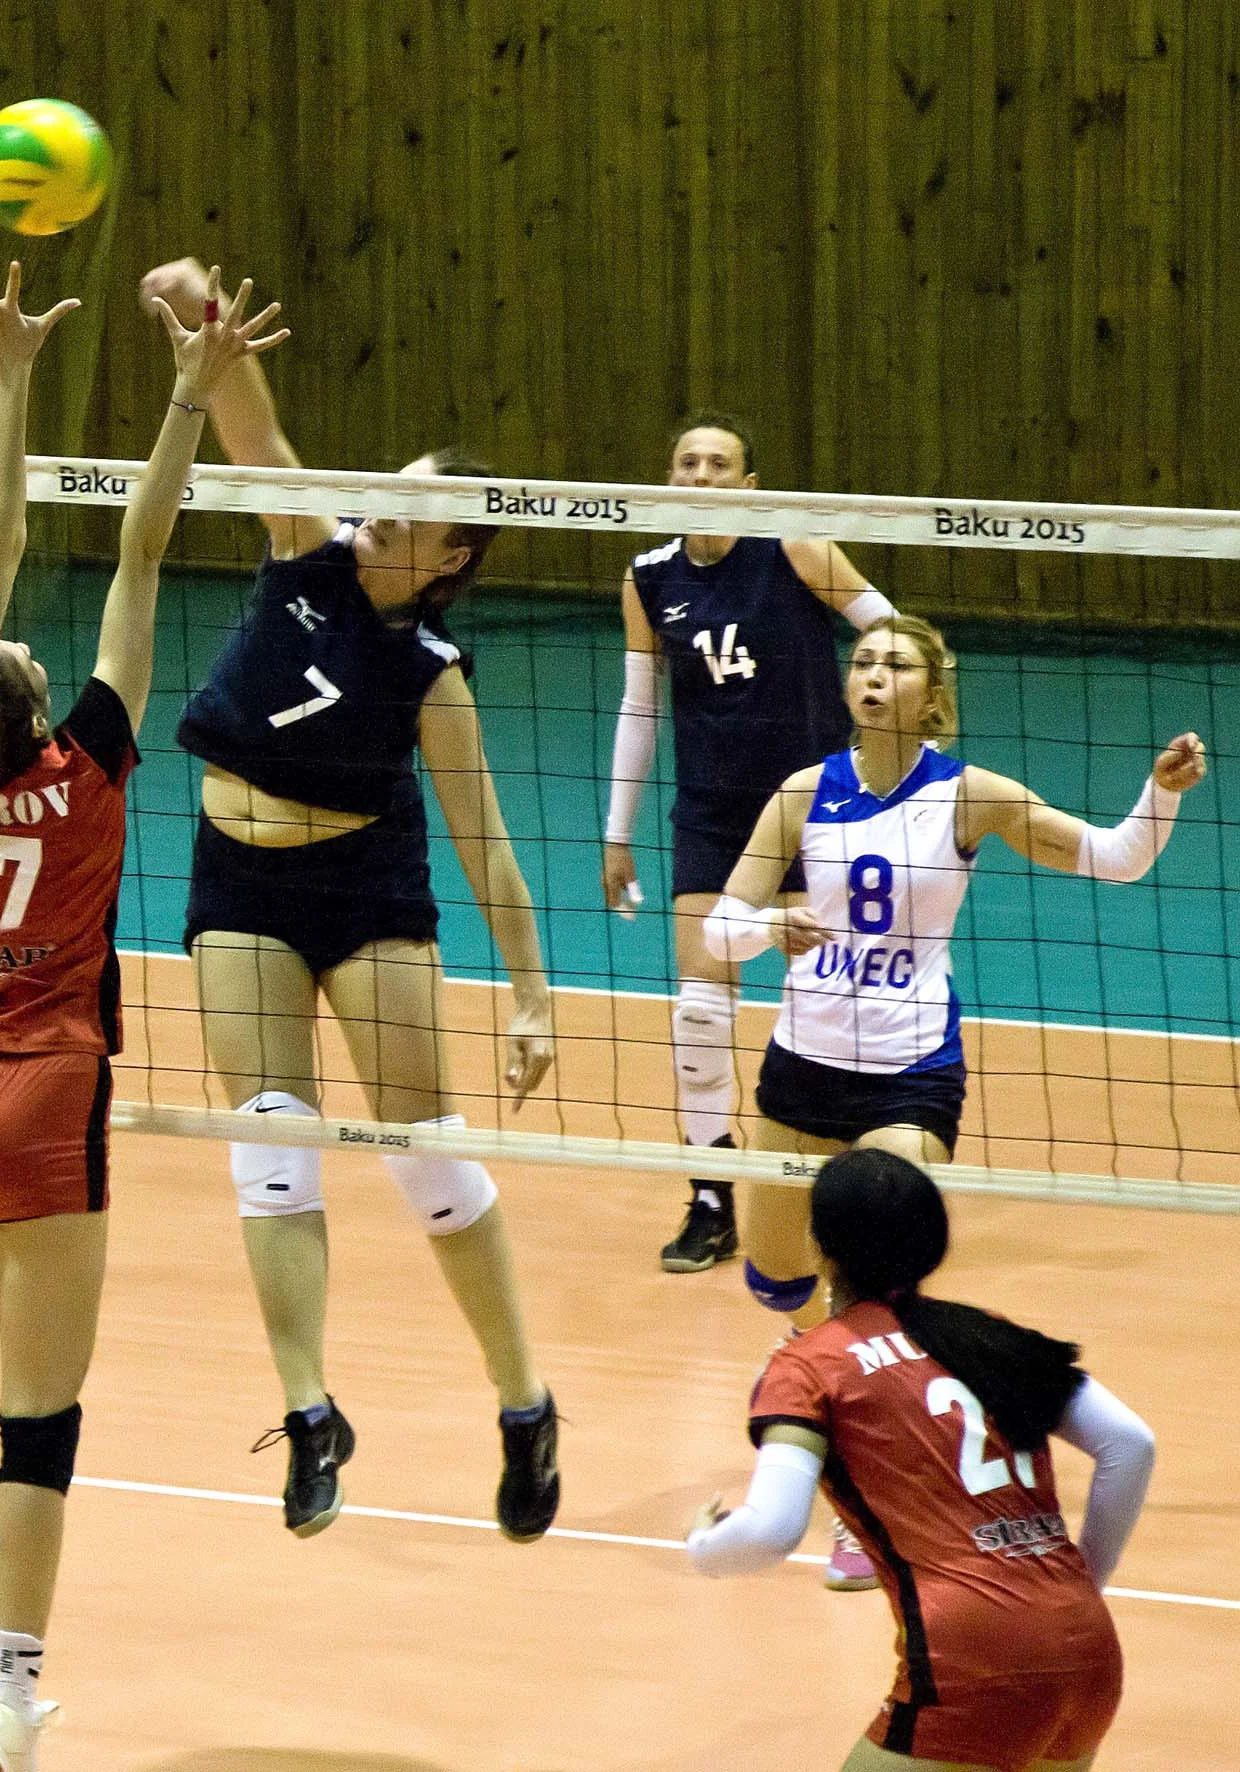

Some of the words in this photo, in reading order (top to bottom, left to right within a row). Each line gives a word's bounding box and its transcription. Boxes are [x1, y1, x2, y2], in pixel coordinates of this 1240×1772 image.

[58, 466, 127, 495] Baku
[484, 486, 557, 517] Baku
[566, 496, 628, 524] 2015
[934, 507, 1010, 537] Baku
[1020, 517, 1085, 544] 2015
[692, 623, 757, 684] 14
[268, 664, 343, 728] 7
[848, 854, 894, 935] 8
[815, 943, 915, 989] UNEC
